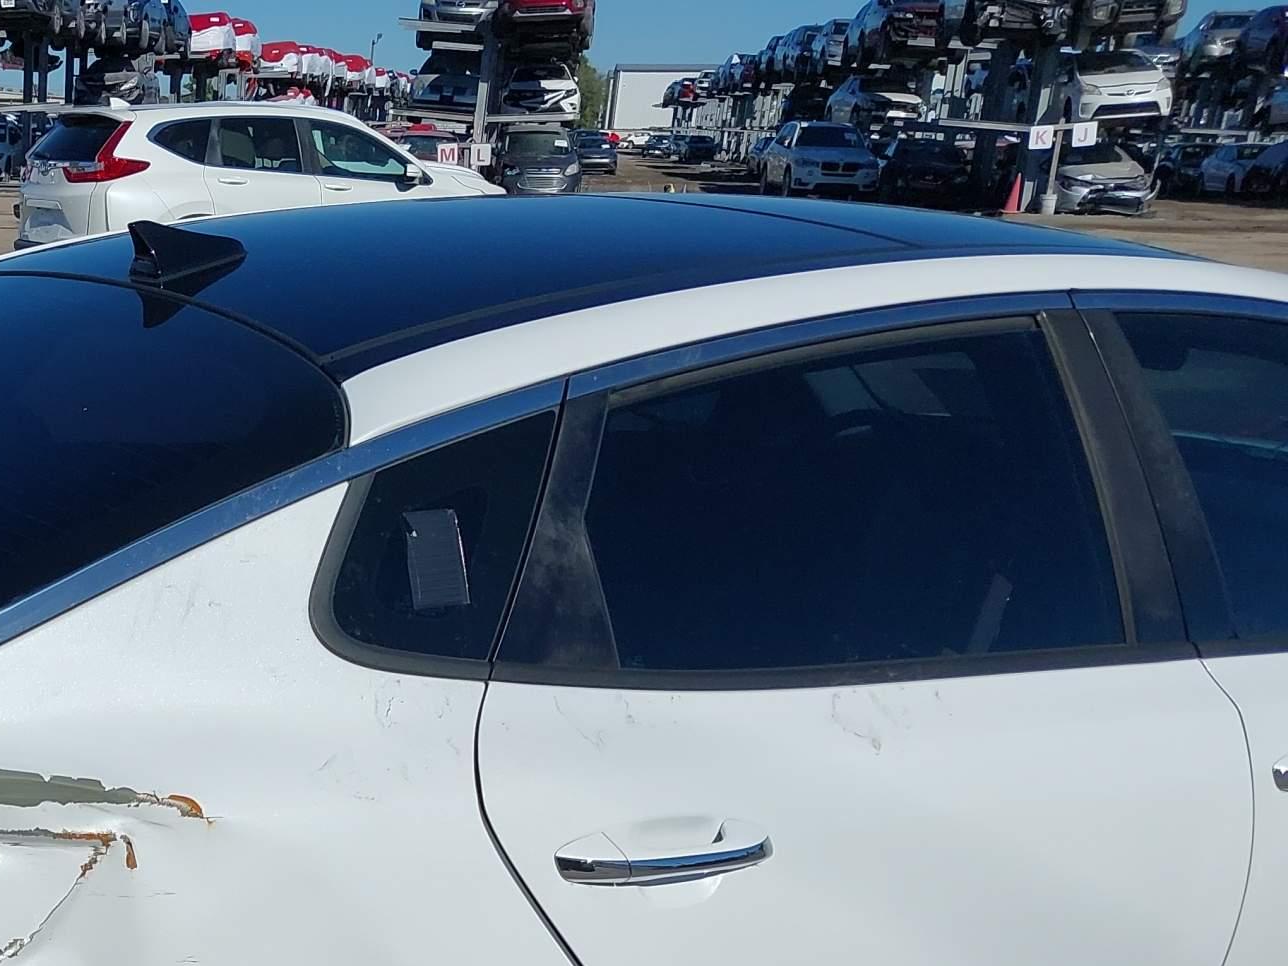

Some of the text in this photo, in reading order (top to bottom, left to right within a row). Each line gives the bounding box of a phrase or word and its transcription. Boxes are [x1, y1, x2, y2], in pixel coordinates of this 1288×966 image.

[1034, 130, 1047, 145] K
[1078, 128, 1088, 142] J
[440, 148, 456, 162] M
[476, 148, 486, 162] L
